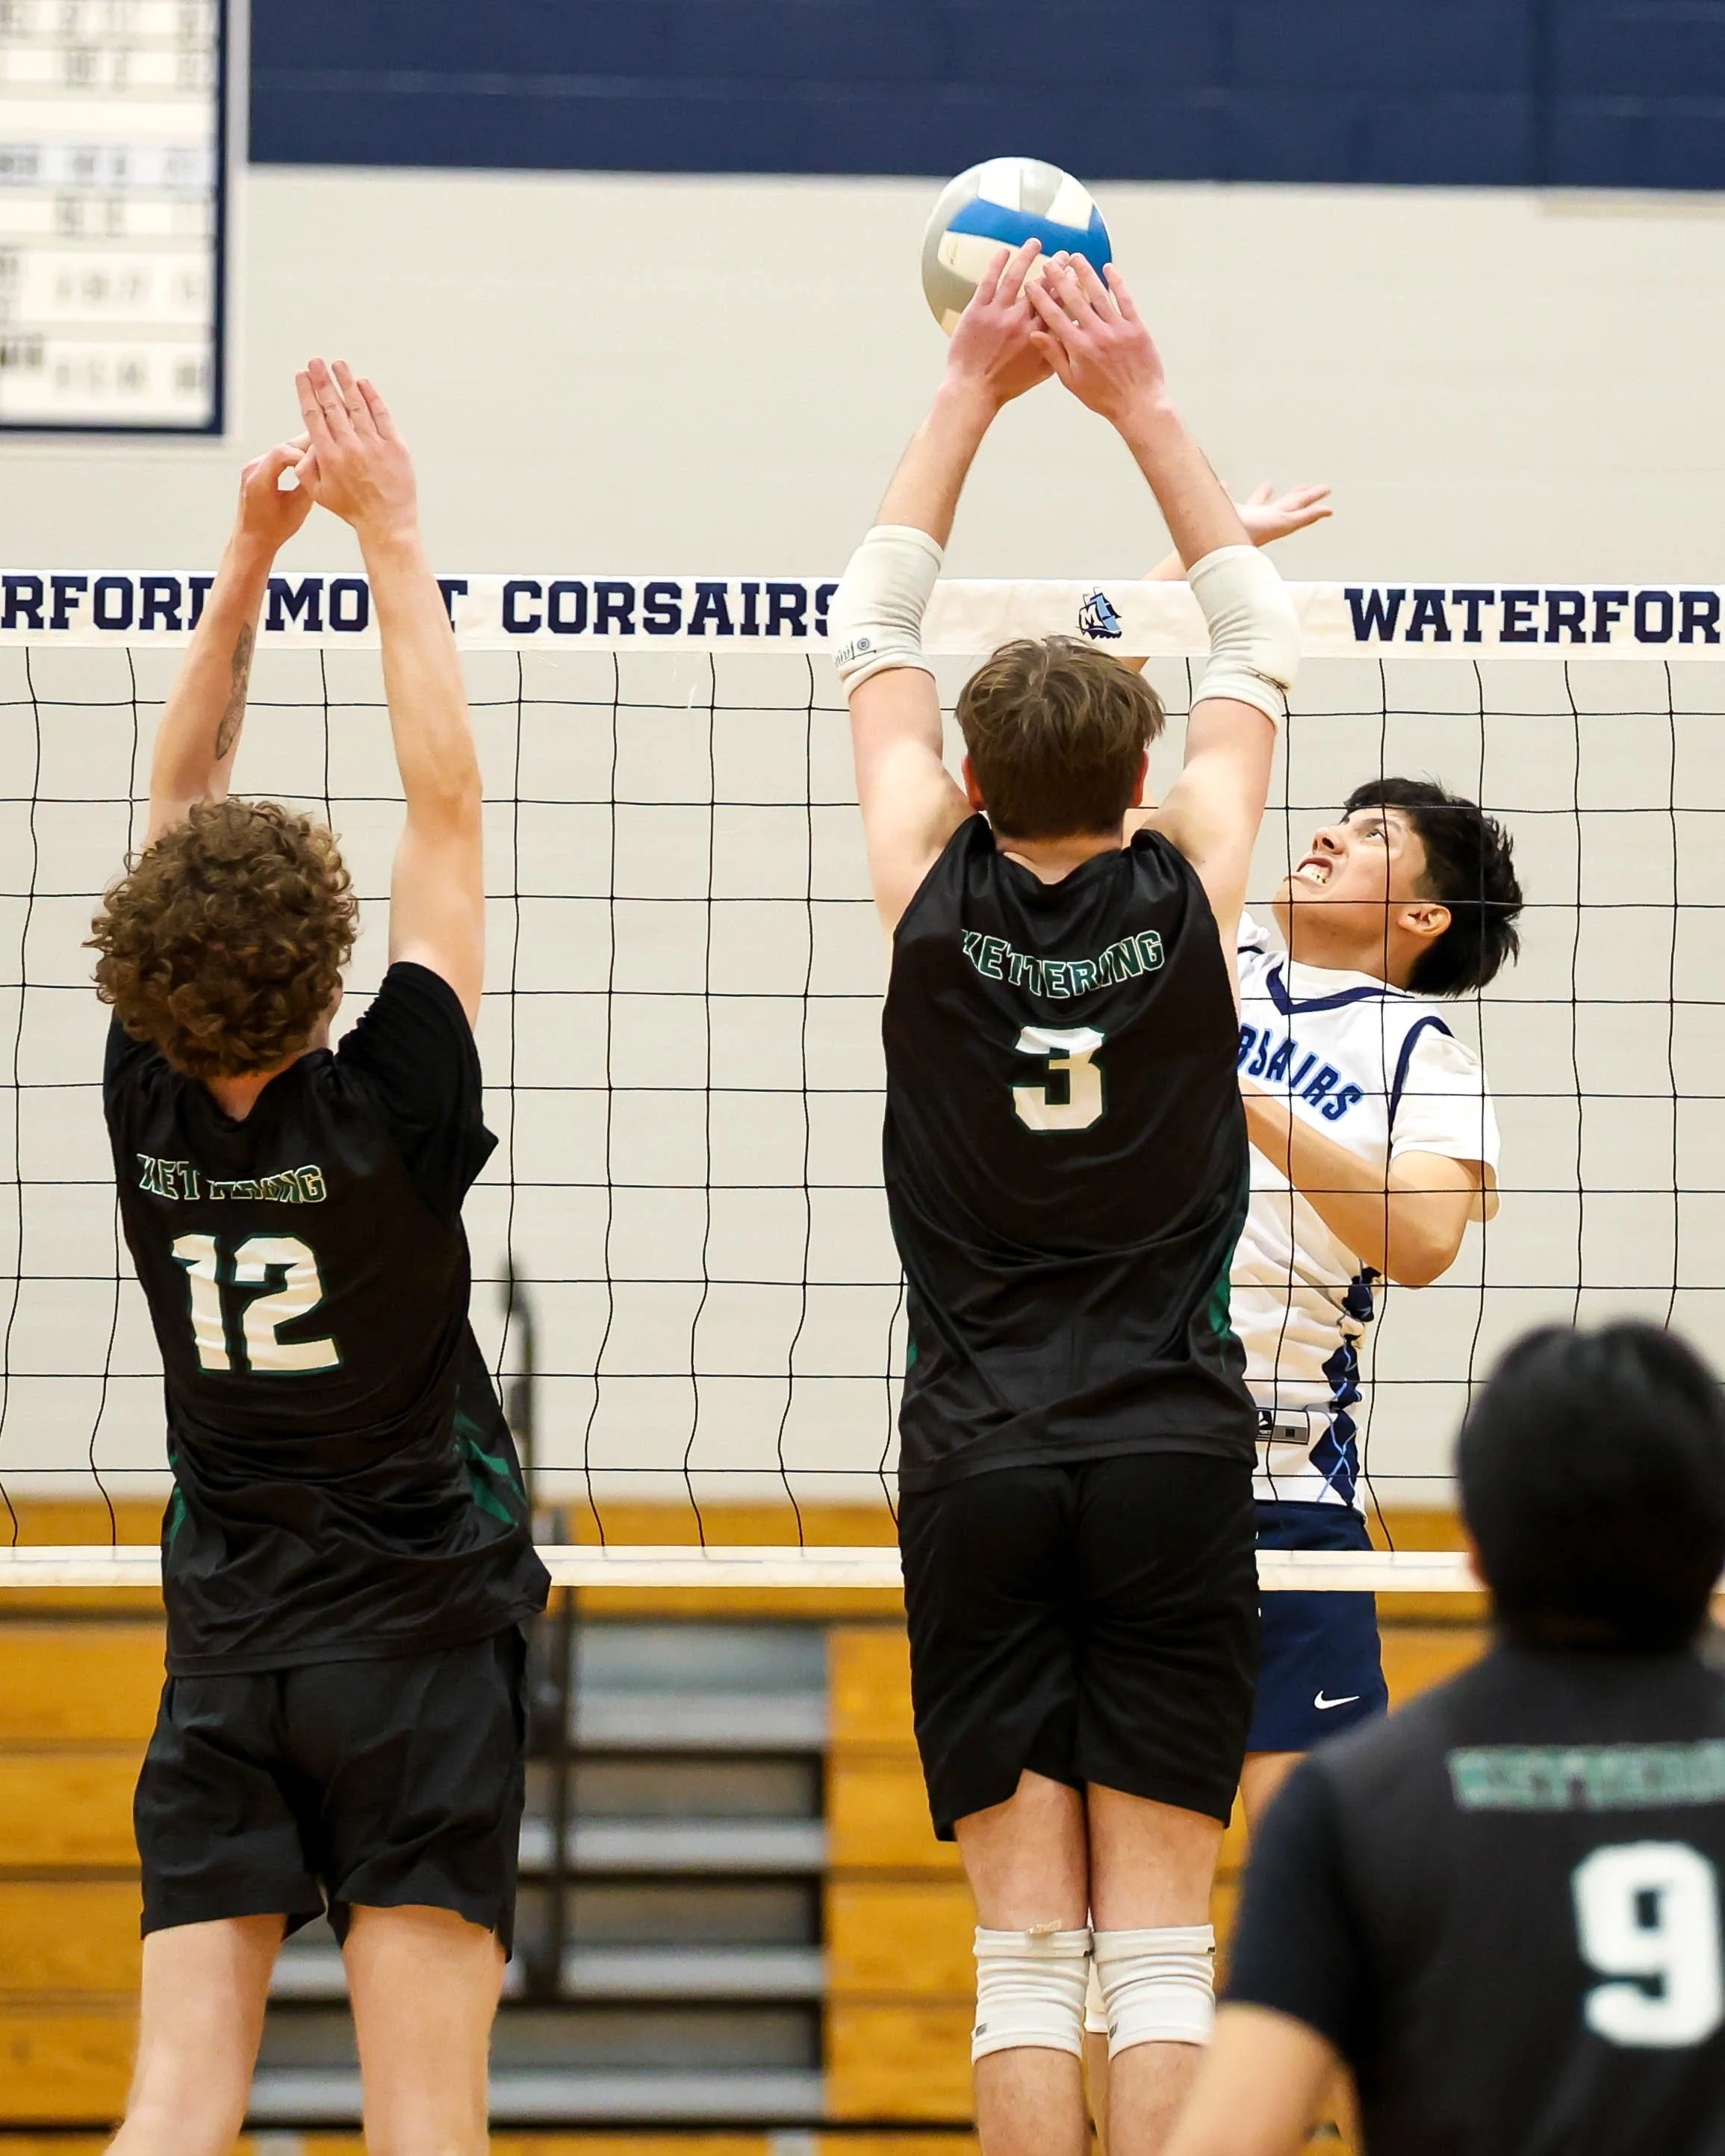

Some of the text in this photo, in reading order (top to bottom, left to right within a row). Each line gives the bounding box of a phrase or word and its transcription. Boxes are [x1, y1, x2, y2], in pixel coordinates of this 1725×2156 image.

[264, 577, 468, 633] MOT
[1344, 588, 1721, 644] WATERFOR
[1012, 1025, 1105, 1131] 3
[171, 1233, 341, 1373] 12
[1570, 1839, 1724, 2051] 9
